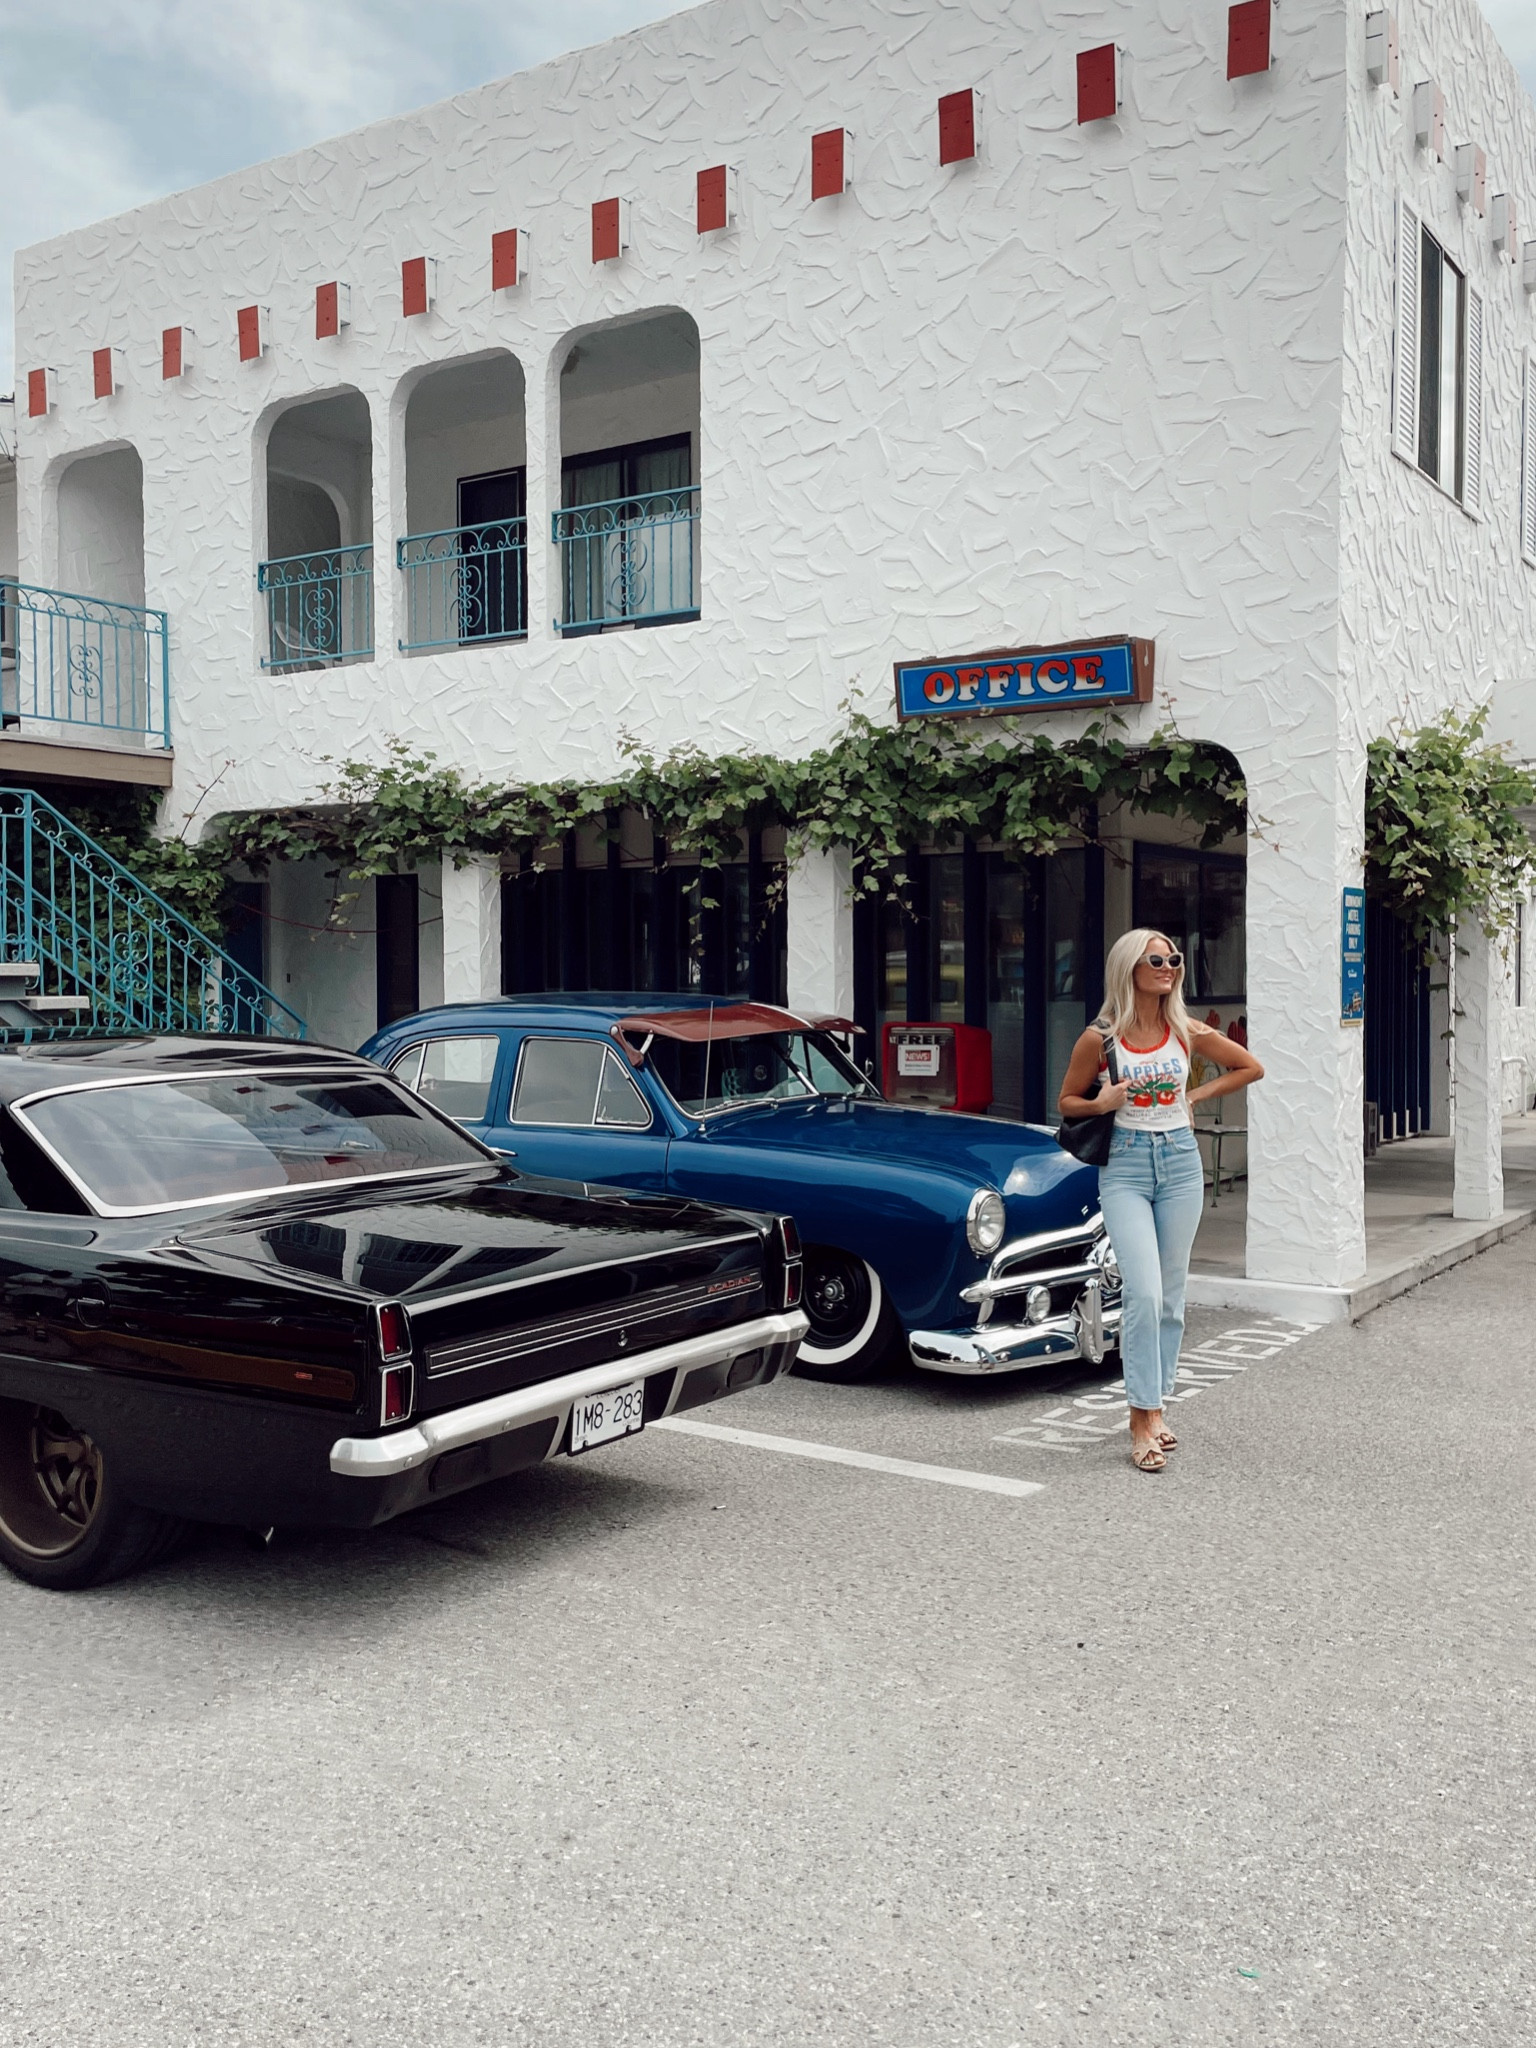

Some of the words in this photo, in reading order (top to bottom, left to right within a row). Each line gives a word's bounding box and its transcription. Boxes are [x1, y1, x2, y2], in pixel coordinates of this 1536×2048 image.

[923, 655, 1105, 704] OFFICE
[898, 1034, 946, 1045] FREE
[1122, 1058, 1182, 1080] APPLES
[708, 1276, 751, 1293] ACADIAN
[576, 1389, 643, 1436] 1M8-283
